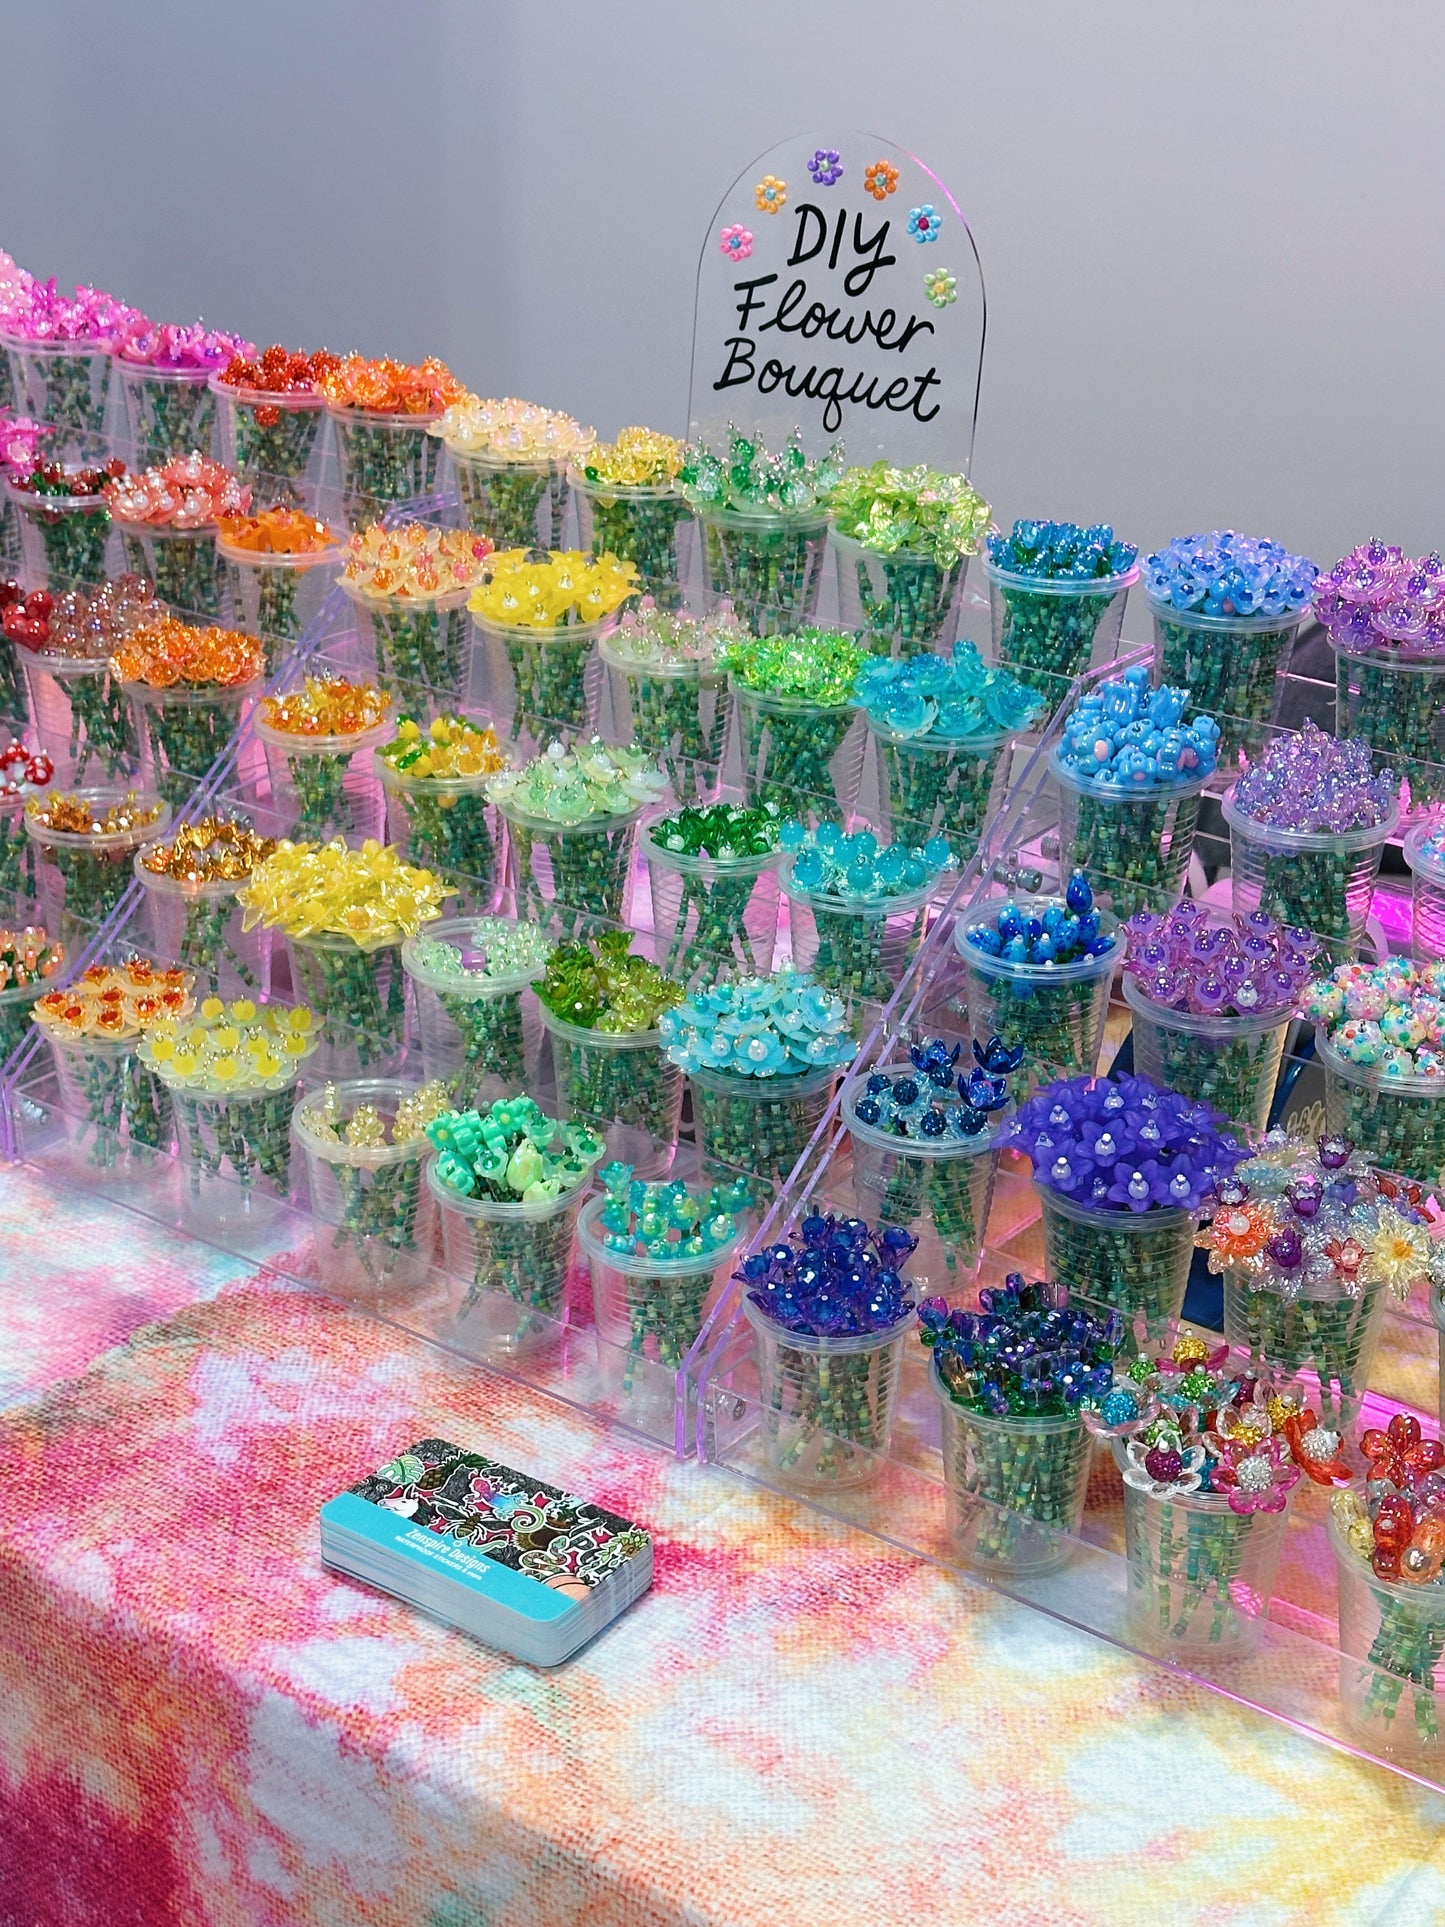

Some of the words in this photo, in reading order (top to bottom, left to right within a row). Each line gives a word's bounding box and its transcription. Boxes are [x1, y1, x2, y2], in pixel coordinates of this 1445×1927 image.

[787, 203, 896, 297] DIY
[733, 273, 935, 353] Flower
[713, 337, 942, 433] Bouquet
[405, 1528, 451, 1554] Zenspire
[448, 1548, 491, 1573] Designs
[432, 1554, 463, 1571] STICKERS
